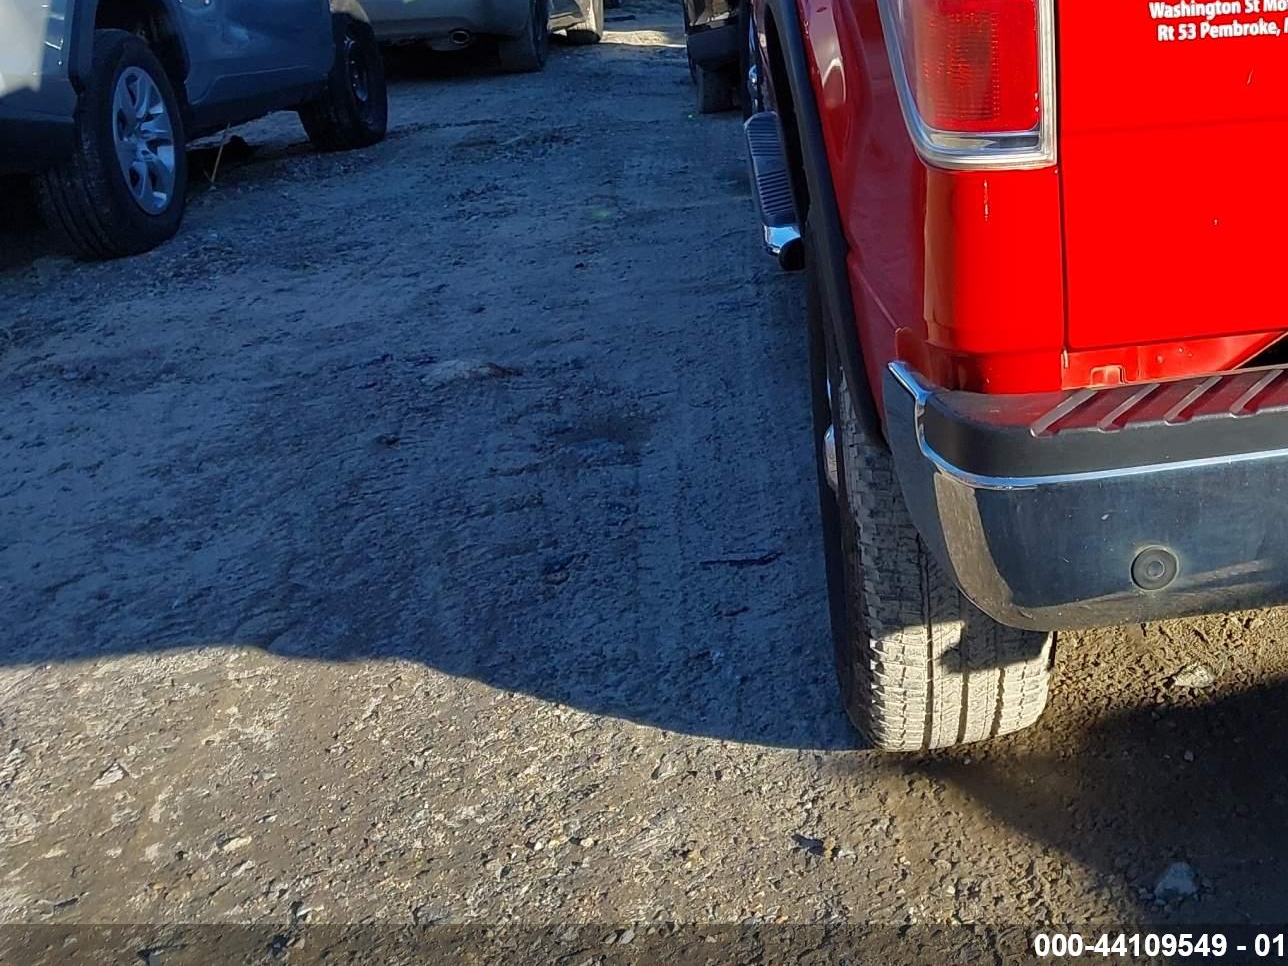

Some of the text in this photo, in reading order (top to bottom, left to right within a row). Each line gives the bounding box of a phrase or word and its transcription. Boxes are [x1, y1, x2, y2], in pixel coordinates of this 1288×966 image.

[1149, 0, 1241, 20] Washington
[1158, 24, 1174, 41] Rt
[1178, 23, 1196, 40] 53
[1201, 19, 1280, 39] Pembroke,
